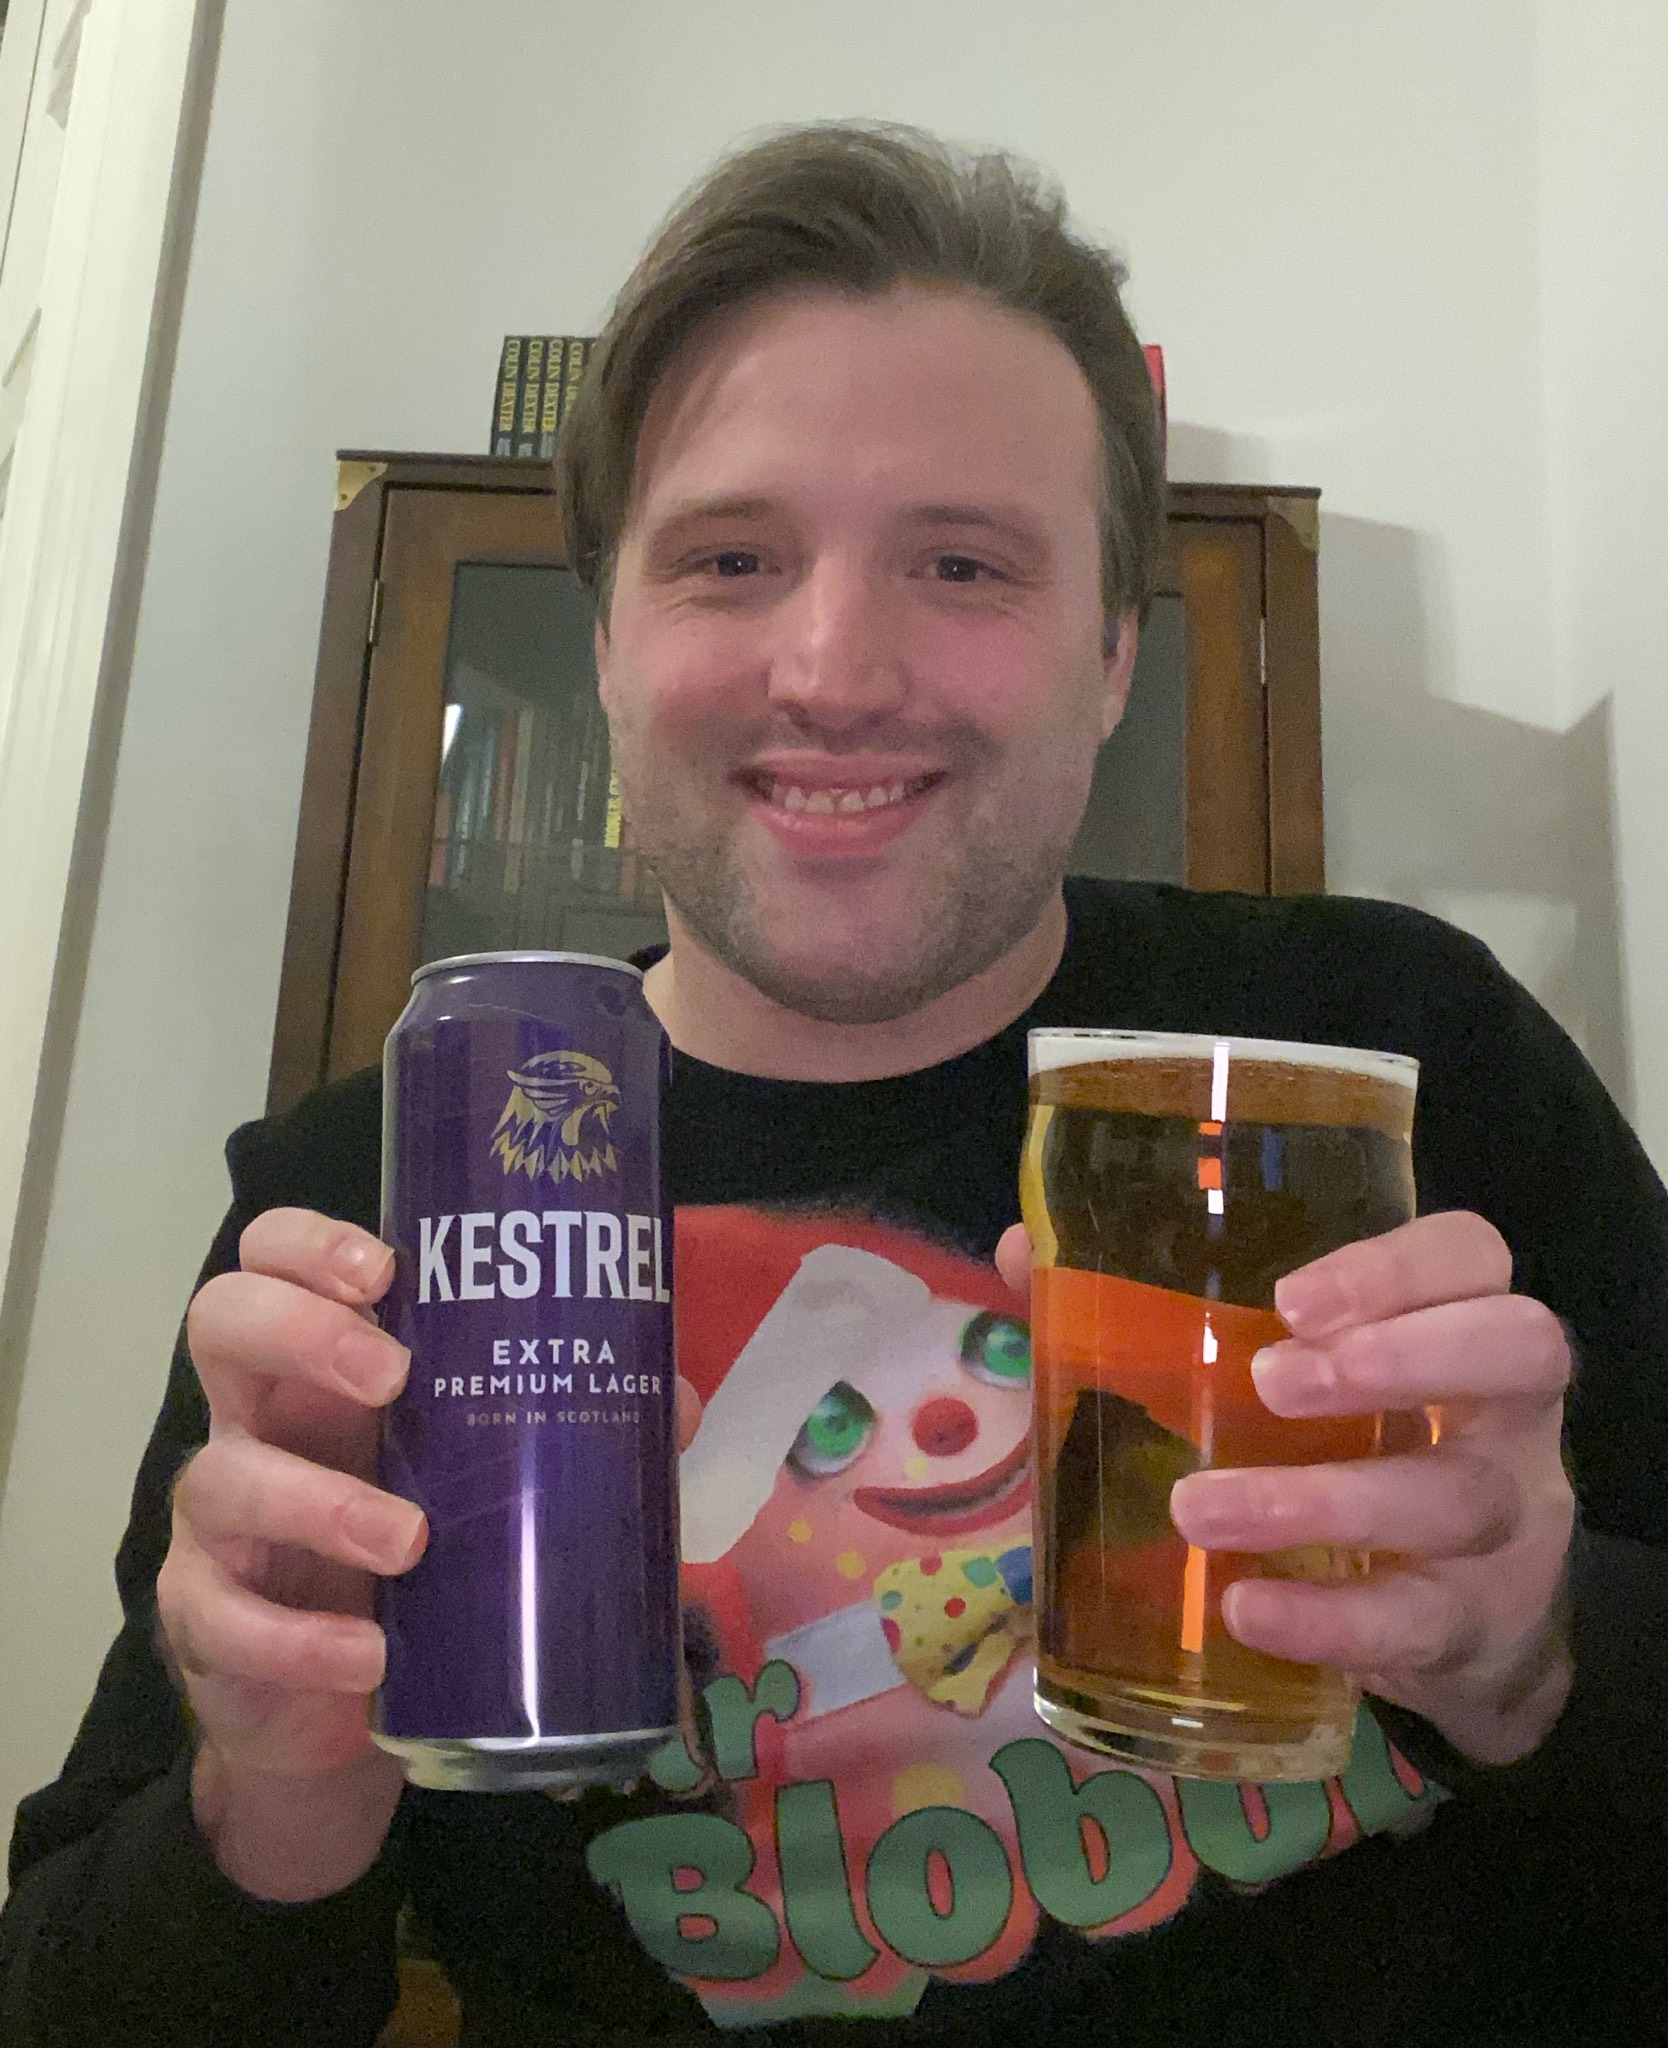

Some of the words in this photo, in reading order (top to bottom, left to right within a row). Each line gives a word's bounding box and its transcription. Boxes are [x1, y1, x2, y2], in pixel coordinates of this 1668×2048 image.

[547, 340, 564, 379] COLIN
[522, 383, 540, 434] DEXTER
[541, 382, 560, 432] DEXTER
[417, 1210, 670, 1304] KESTREL
[492, 1339, 615, 1366] EXTRA
[434, 1373, 573, 1397] PREMIUM
[589, 1374, 661, 1395] LAGER
[467, 1411, 516, 1426] BORN
[526, 1411, 547, 1424] IN
